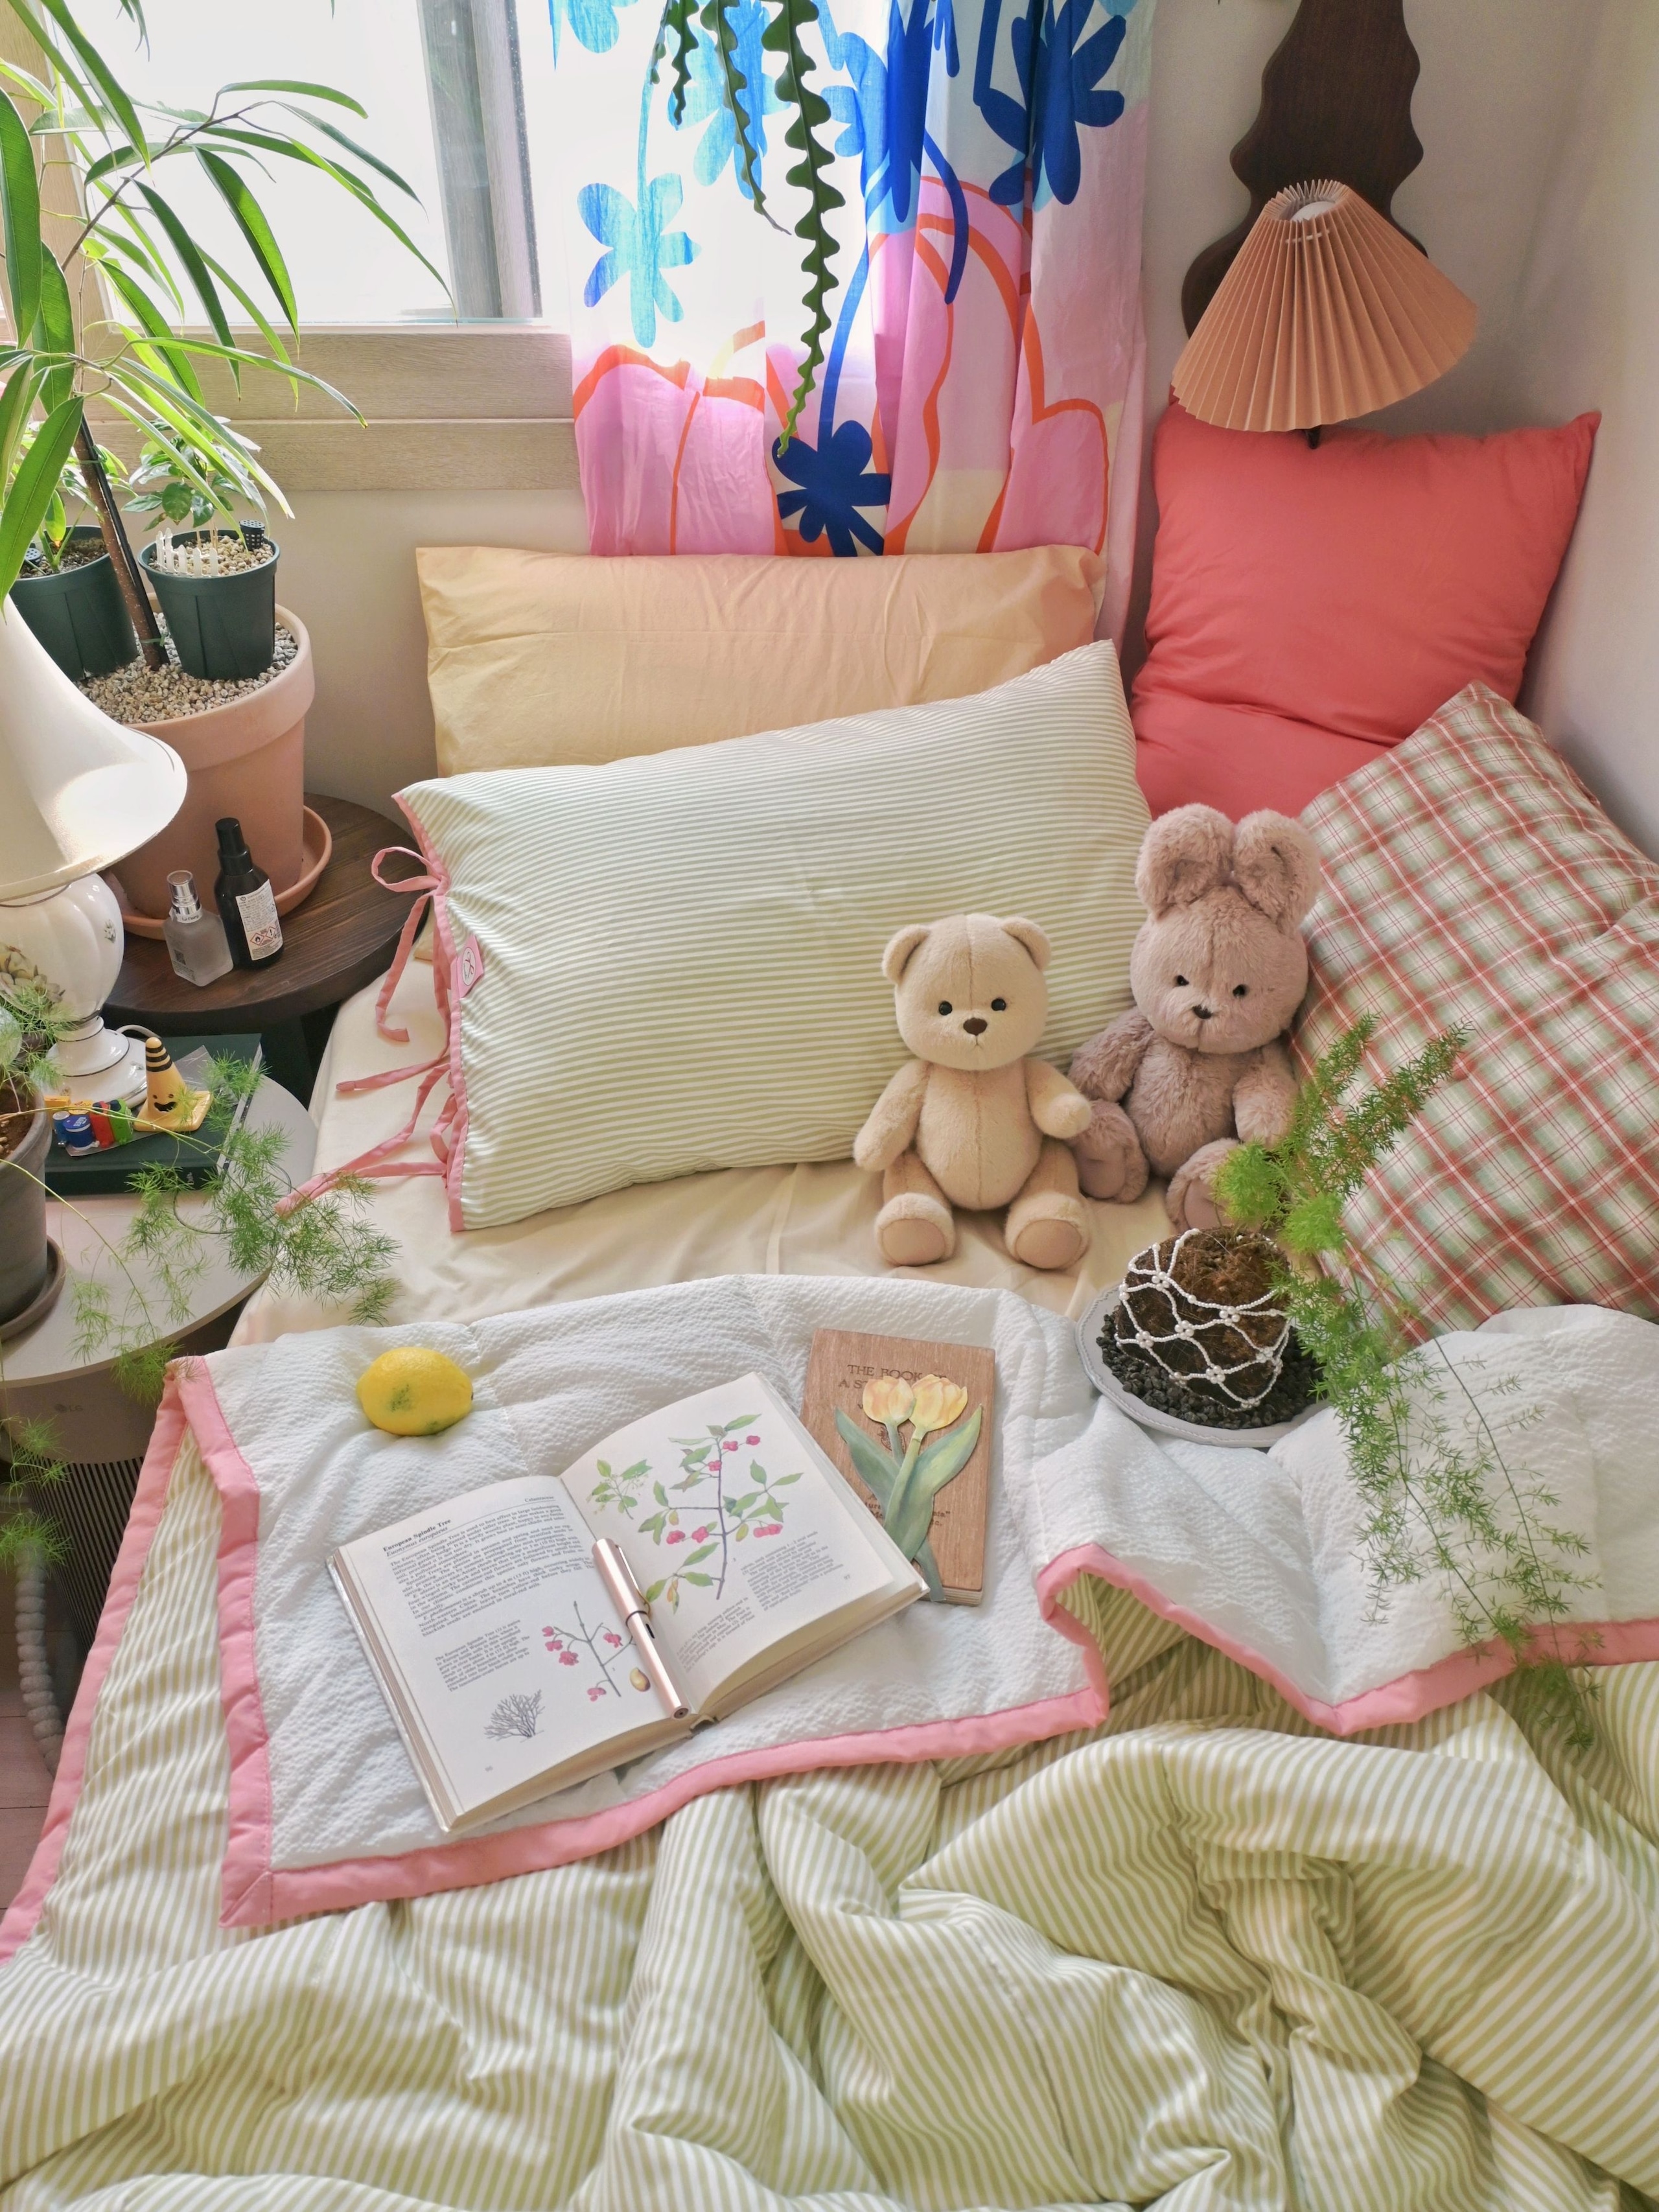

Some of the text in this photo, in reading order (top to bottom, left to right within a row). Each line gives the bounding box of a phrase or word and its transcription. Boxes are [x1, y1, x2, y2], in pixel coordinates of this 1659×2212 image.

[847, 1364, 874, 1376] THE
[881, 1368, 922, 1381] BOOK
[838, 1379, 850, 1388] A
[383, 1537, 412, 1552] European
[413, 1526, 435, 1538] Spindle
[387, 1527, 448, 1557] Euonymus europaeus
